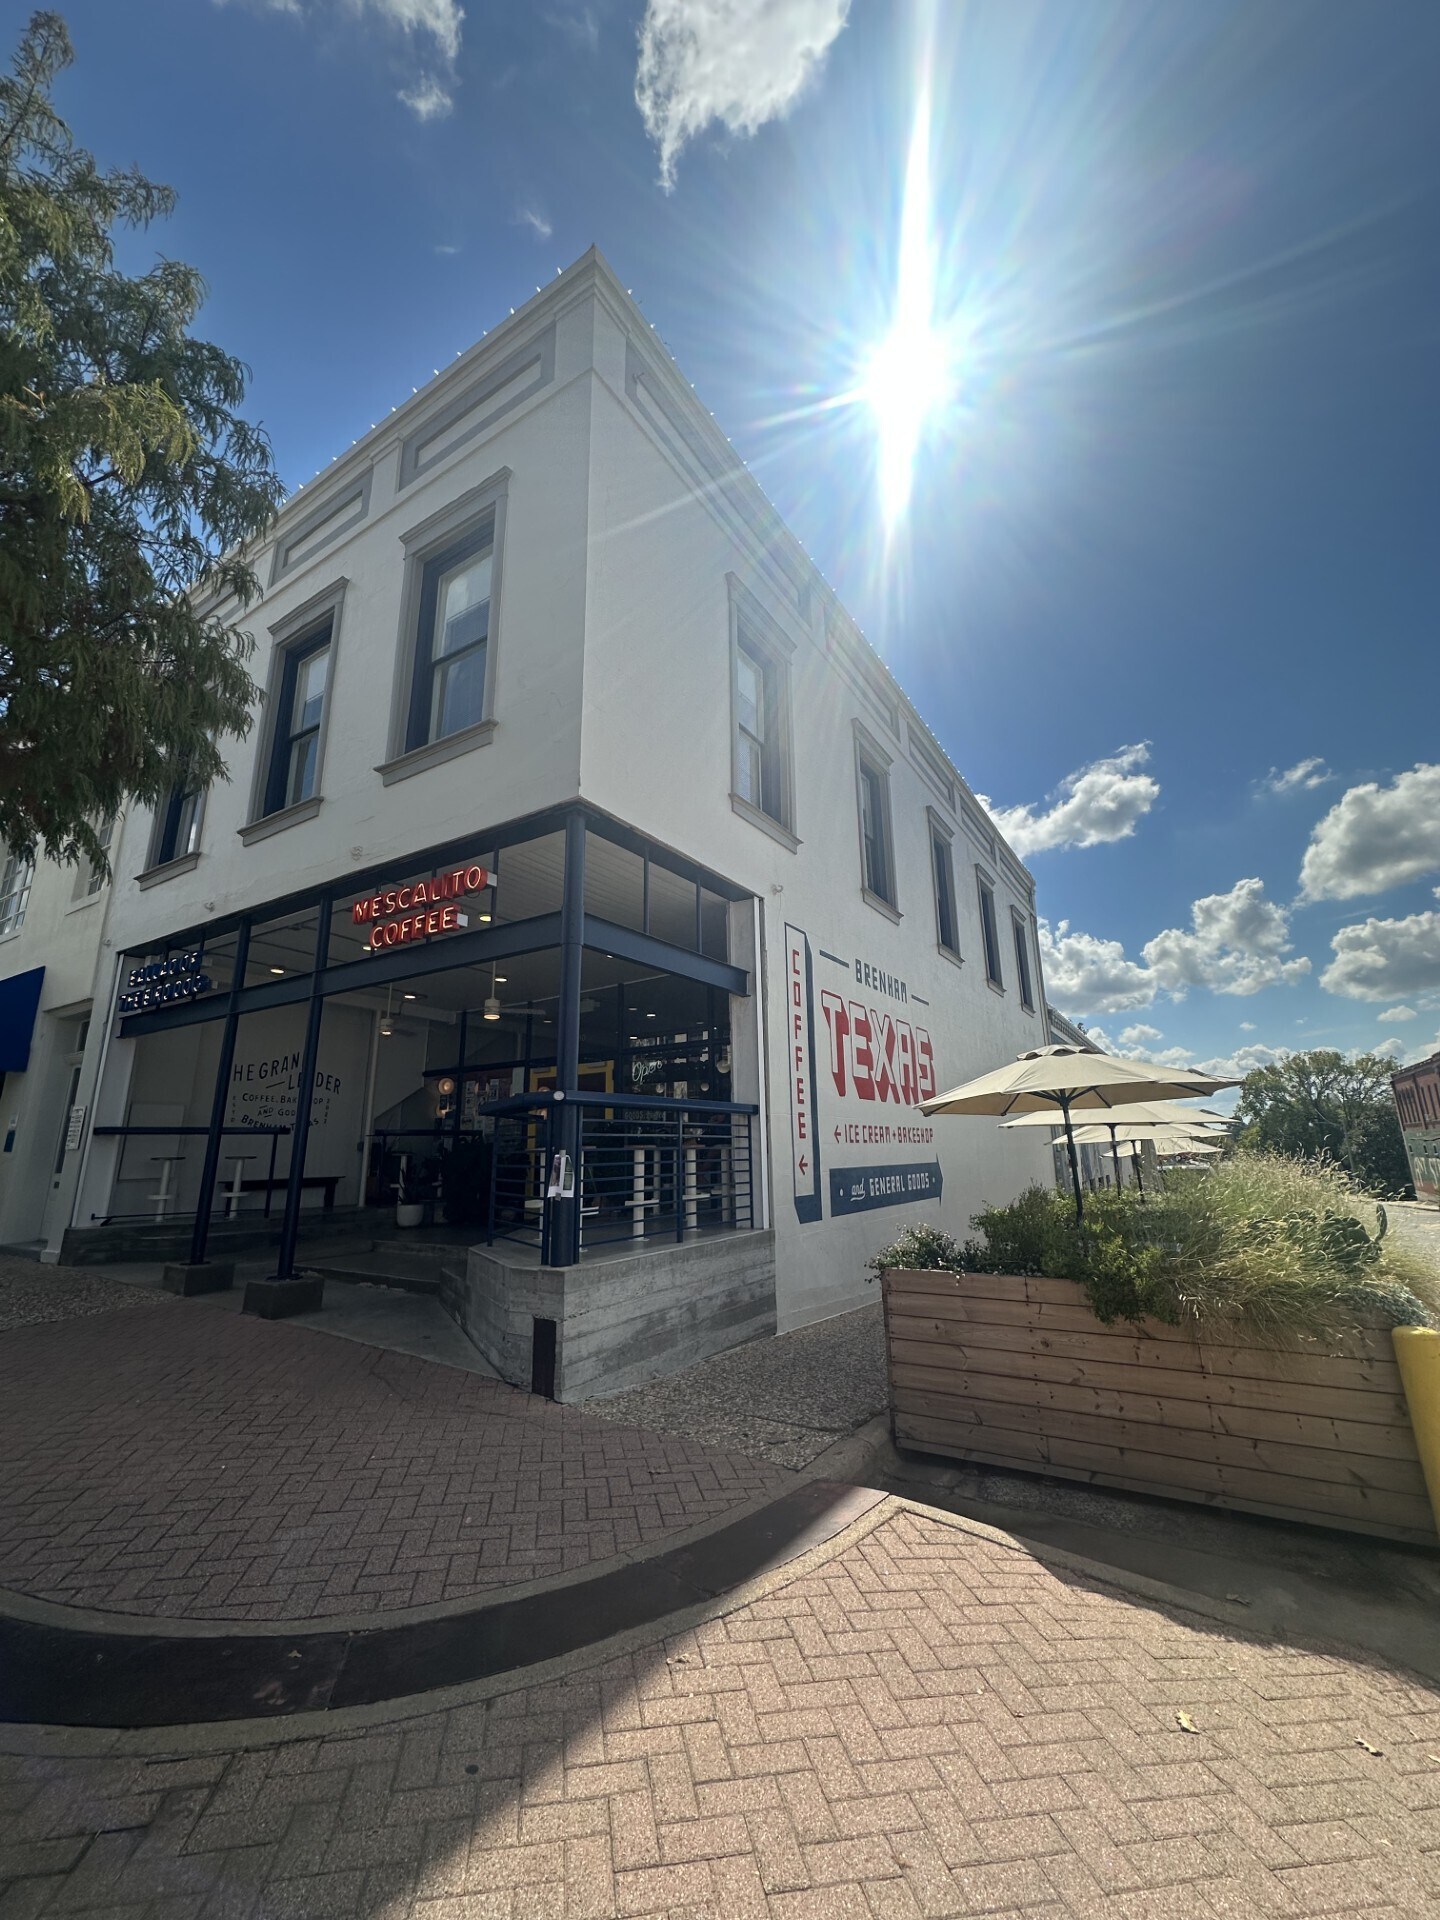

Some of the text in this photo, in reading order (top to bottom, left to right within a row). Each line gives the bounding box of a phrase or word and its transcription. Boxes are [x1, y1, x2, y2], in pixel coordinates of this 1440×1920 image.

[352, 864, 488, 924] MESCALITO
[369, 903, 460, 948] COFFEE
[128, 951, 202, 987] BALLAD OF
[855, 958, 908, 1003] BRENHAM
[119, 990, 143, 1011] THE
[174, 974, 210, 998] DOG
[792, 948, 807, 1139] COFFEE
[821, 989, 937, 1105] TEXAS
[233, 1051, 300, 1081] HE GRAN
[632, 1060, 663, 1085] Open
[280, 1095, 324, 1105] BAKOP
[288, 1072, 341, 1095] LEDER
[257, 1106, 274, 1117] AND
[844, 1124, 860, 1143] ICE
[862, 1124, 891, 1144] CREAM
[897, 1126, 934, 1144] BAKESHOP
[850, 1172, 931, 1201] and GENERAL GOODS
